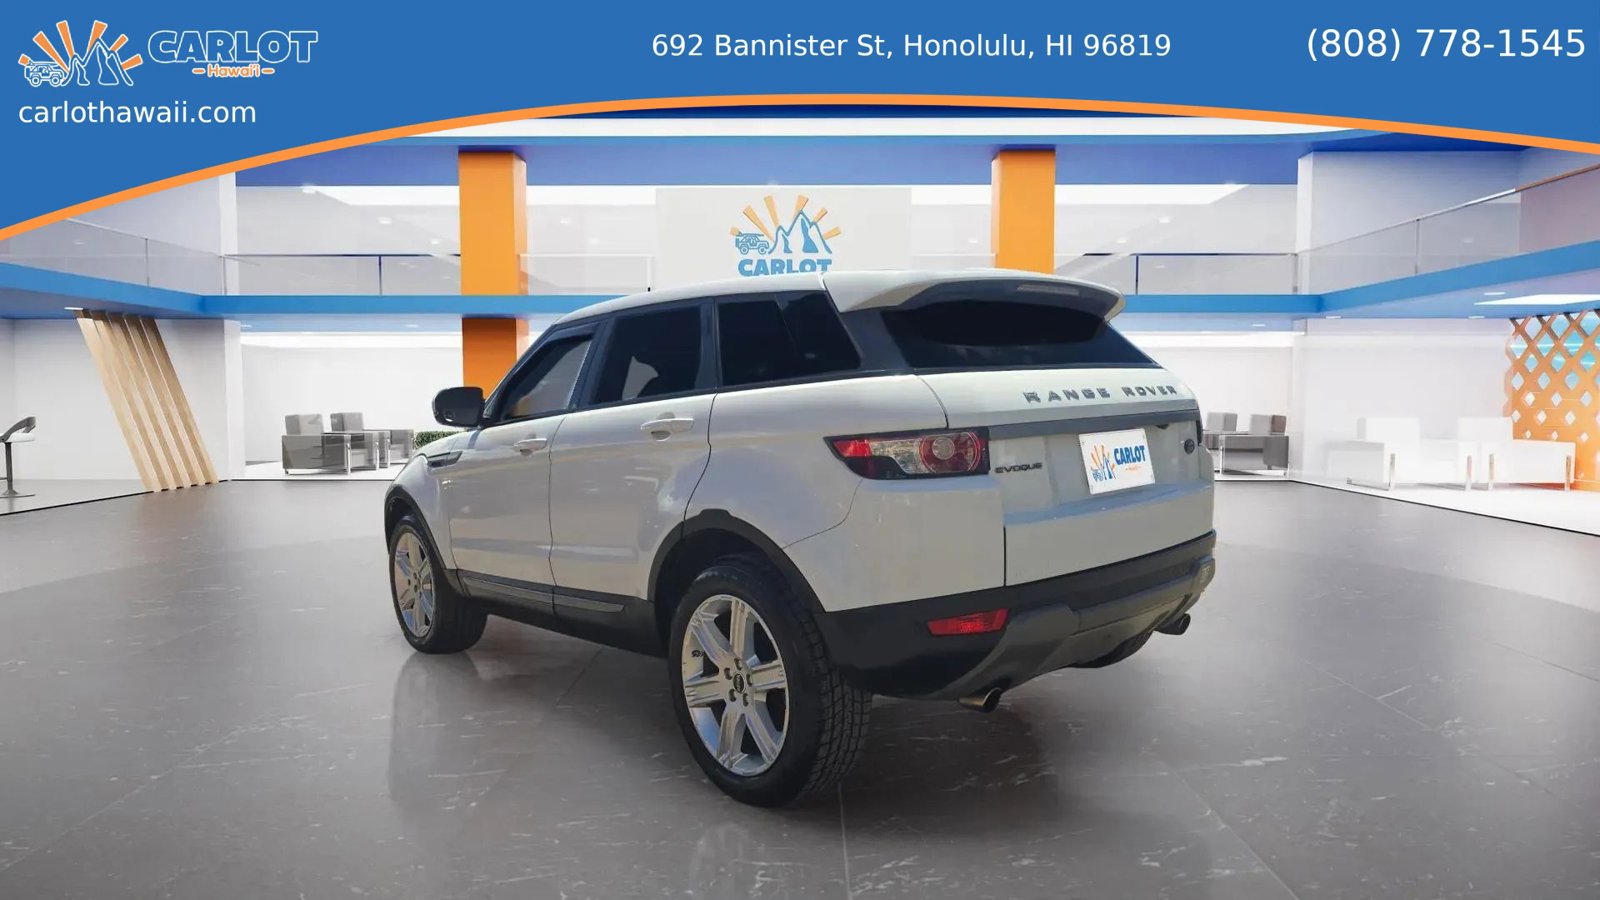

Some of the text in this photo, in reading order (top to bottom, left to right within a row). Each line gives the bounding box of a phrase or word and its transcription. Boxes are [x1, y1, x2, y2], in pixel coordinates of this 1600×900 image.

[738, 258, 832, 277] CARLOT
[1023, 384, 1178, 403] RANGE ROVER
[1113, 445, 1146, 466] CARLOT
[994, 461, 1043, 475] EVOQUE
